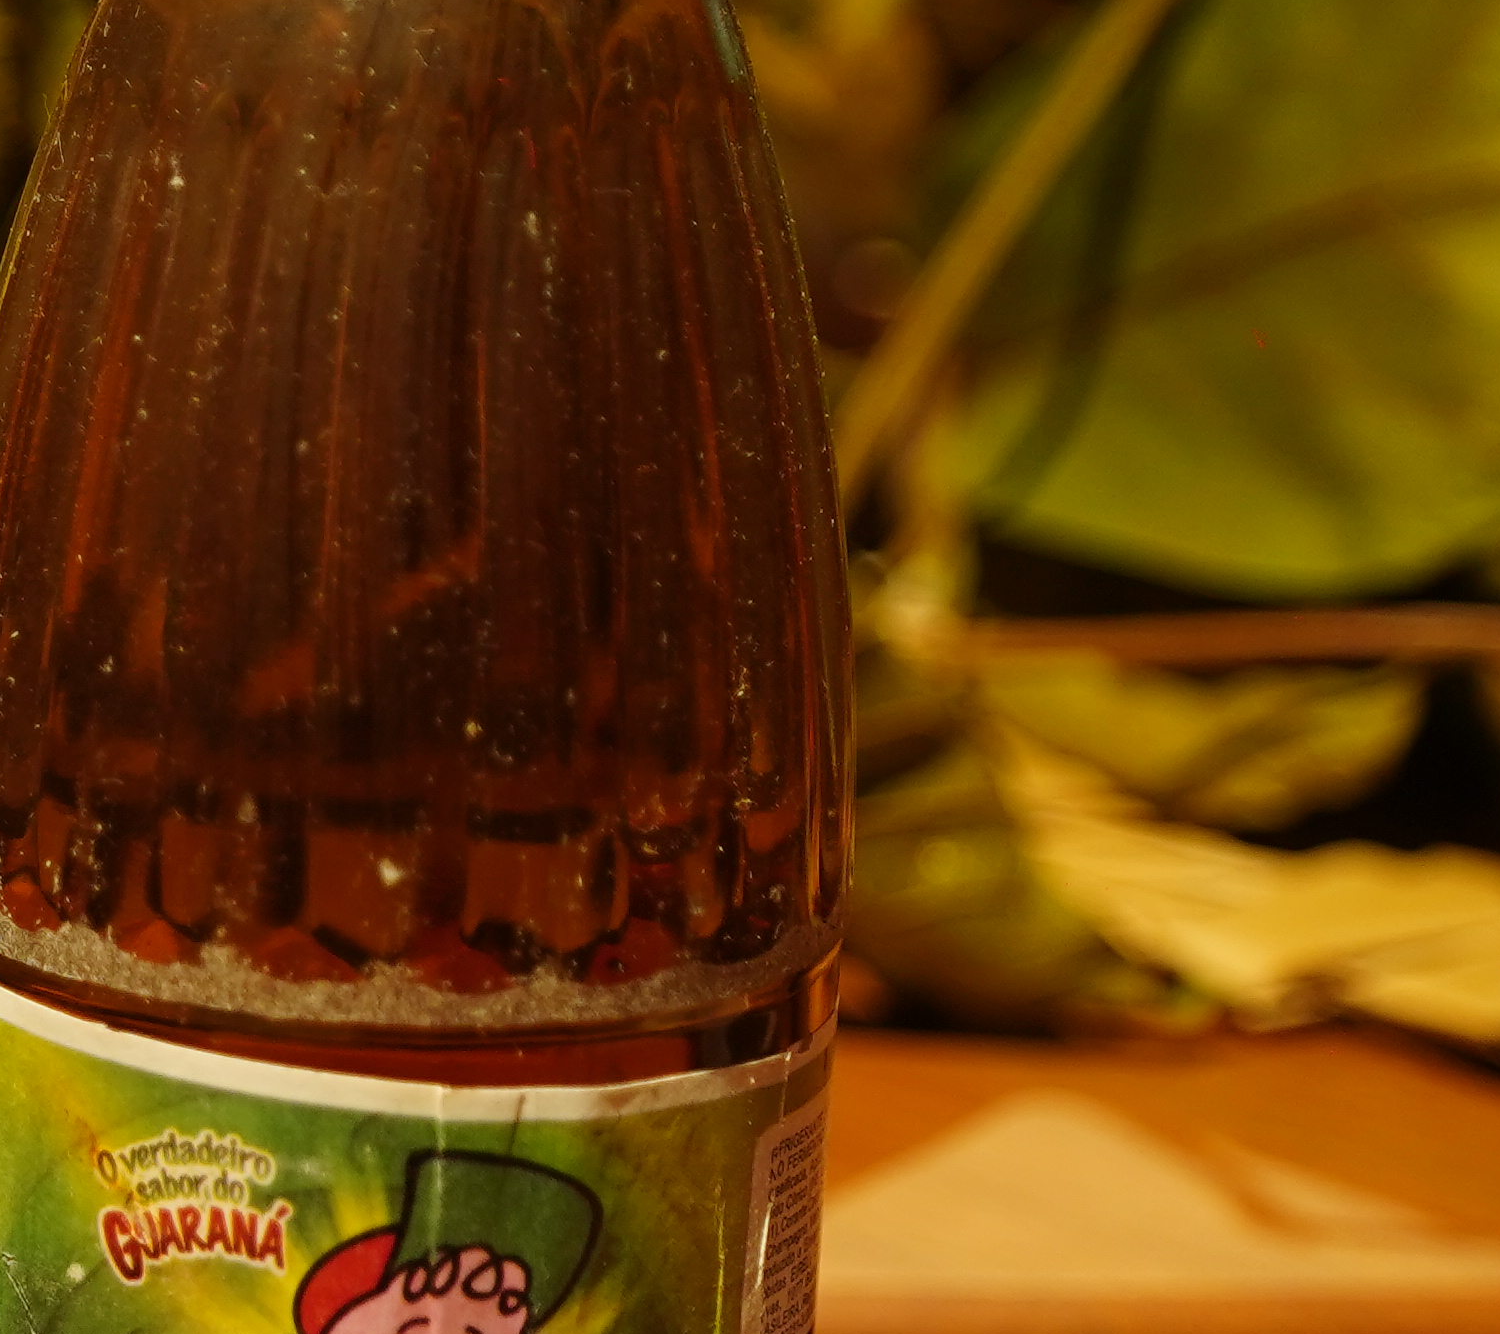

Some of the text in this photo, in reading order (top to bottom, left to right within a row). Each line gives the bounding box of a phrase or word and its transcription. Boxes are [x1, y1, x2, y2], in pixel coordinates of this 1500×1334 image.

[97, 1132, 273, 1184] O verdadeiro
[136, 1167, 246, 1204] sabor do
[103, 1204, 292, 1282] GUARANÁ
